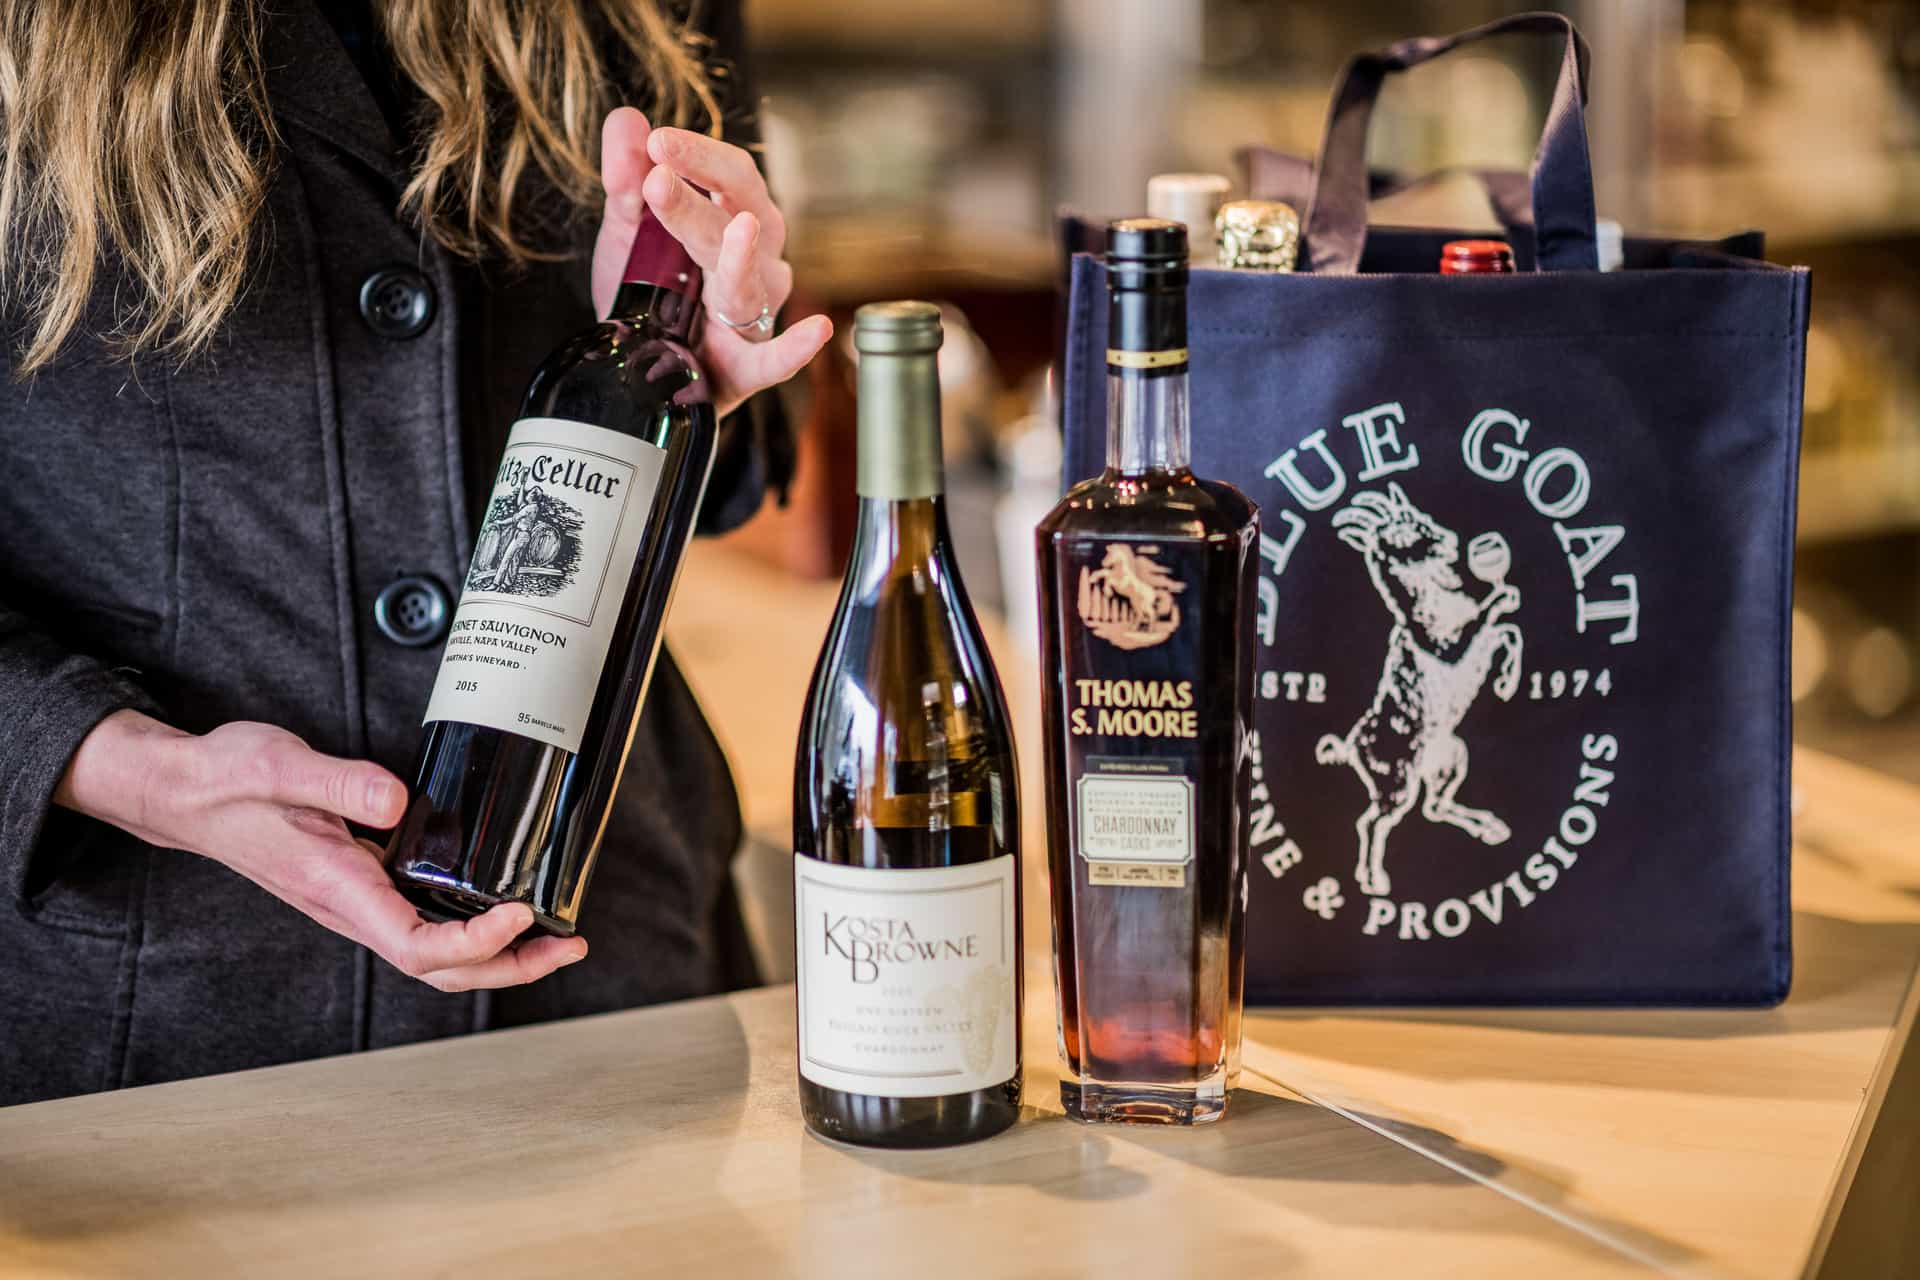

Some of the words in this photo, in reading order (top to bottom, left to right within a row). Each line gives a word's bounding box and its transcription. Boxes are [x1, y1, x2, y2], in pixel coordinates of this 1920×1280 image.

[532, 455, 620, 498] Cellar
[1462, 408, 1640, 645] GOAT
[474, 636, 498, 647] NAPA
[501, 639, 538, 655] VALLEY
[480, 620, 567, 648] SAUVIGNON
[476, 656, 520, 669] VINEYARD
[456, 681, 478, 692] 2015
[1075, 679, 1193, 708] THOMAS
[1530, 668, 1613, 699] 1974
[517, 712, 531, 724] 95
[1072, 708, 1093, 735] S.
[1097, 710, 1198, 738] MOORE
[1094, 816, 1177, 837] CHARDONNAY
[1303, 876, 1345, 920] &
[1363, 734, 1618, 940] PROVISIONS
[823, 911, 915, 960] KOSTA
[851, 934, 979, 984] BROWNE
